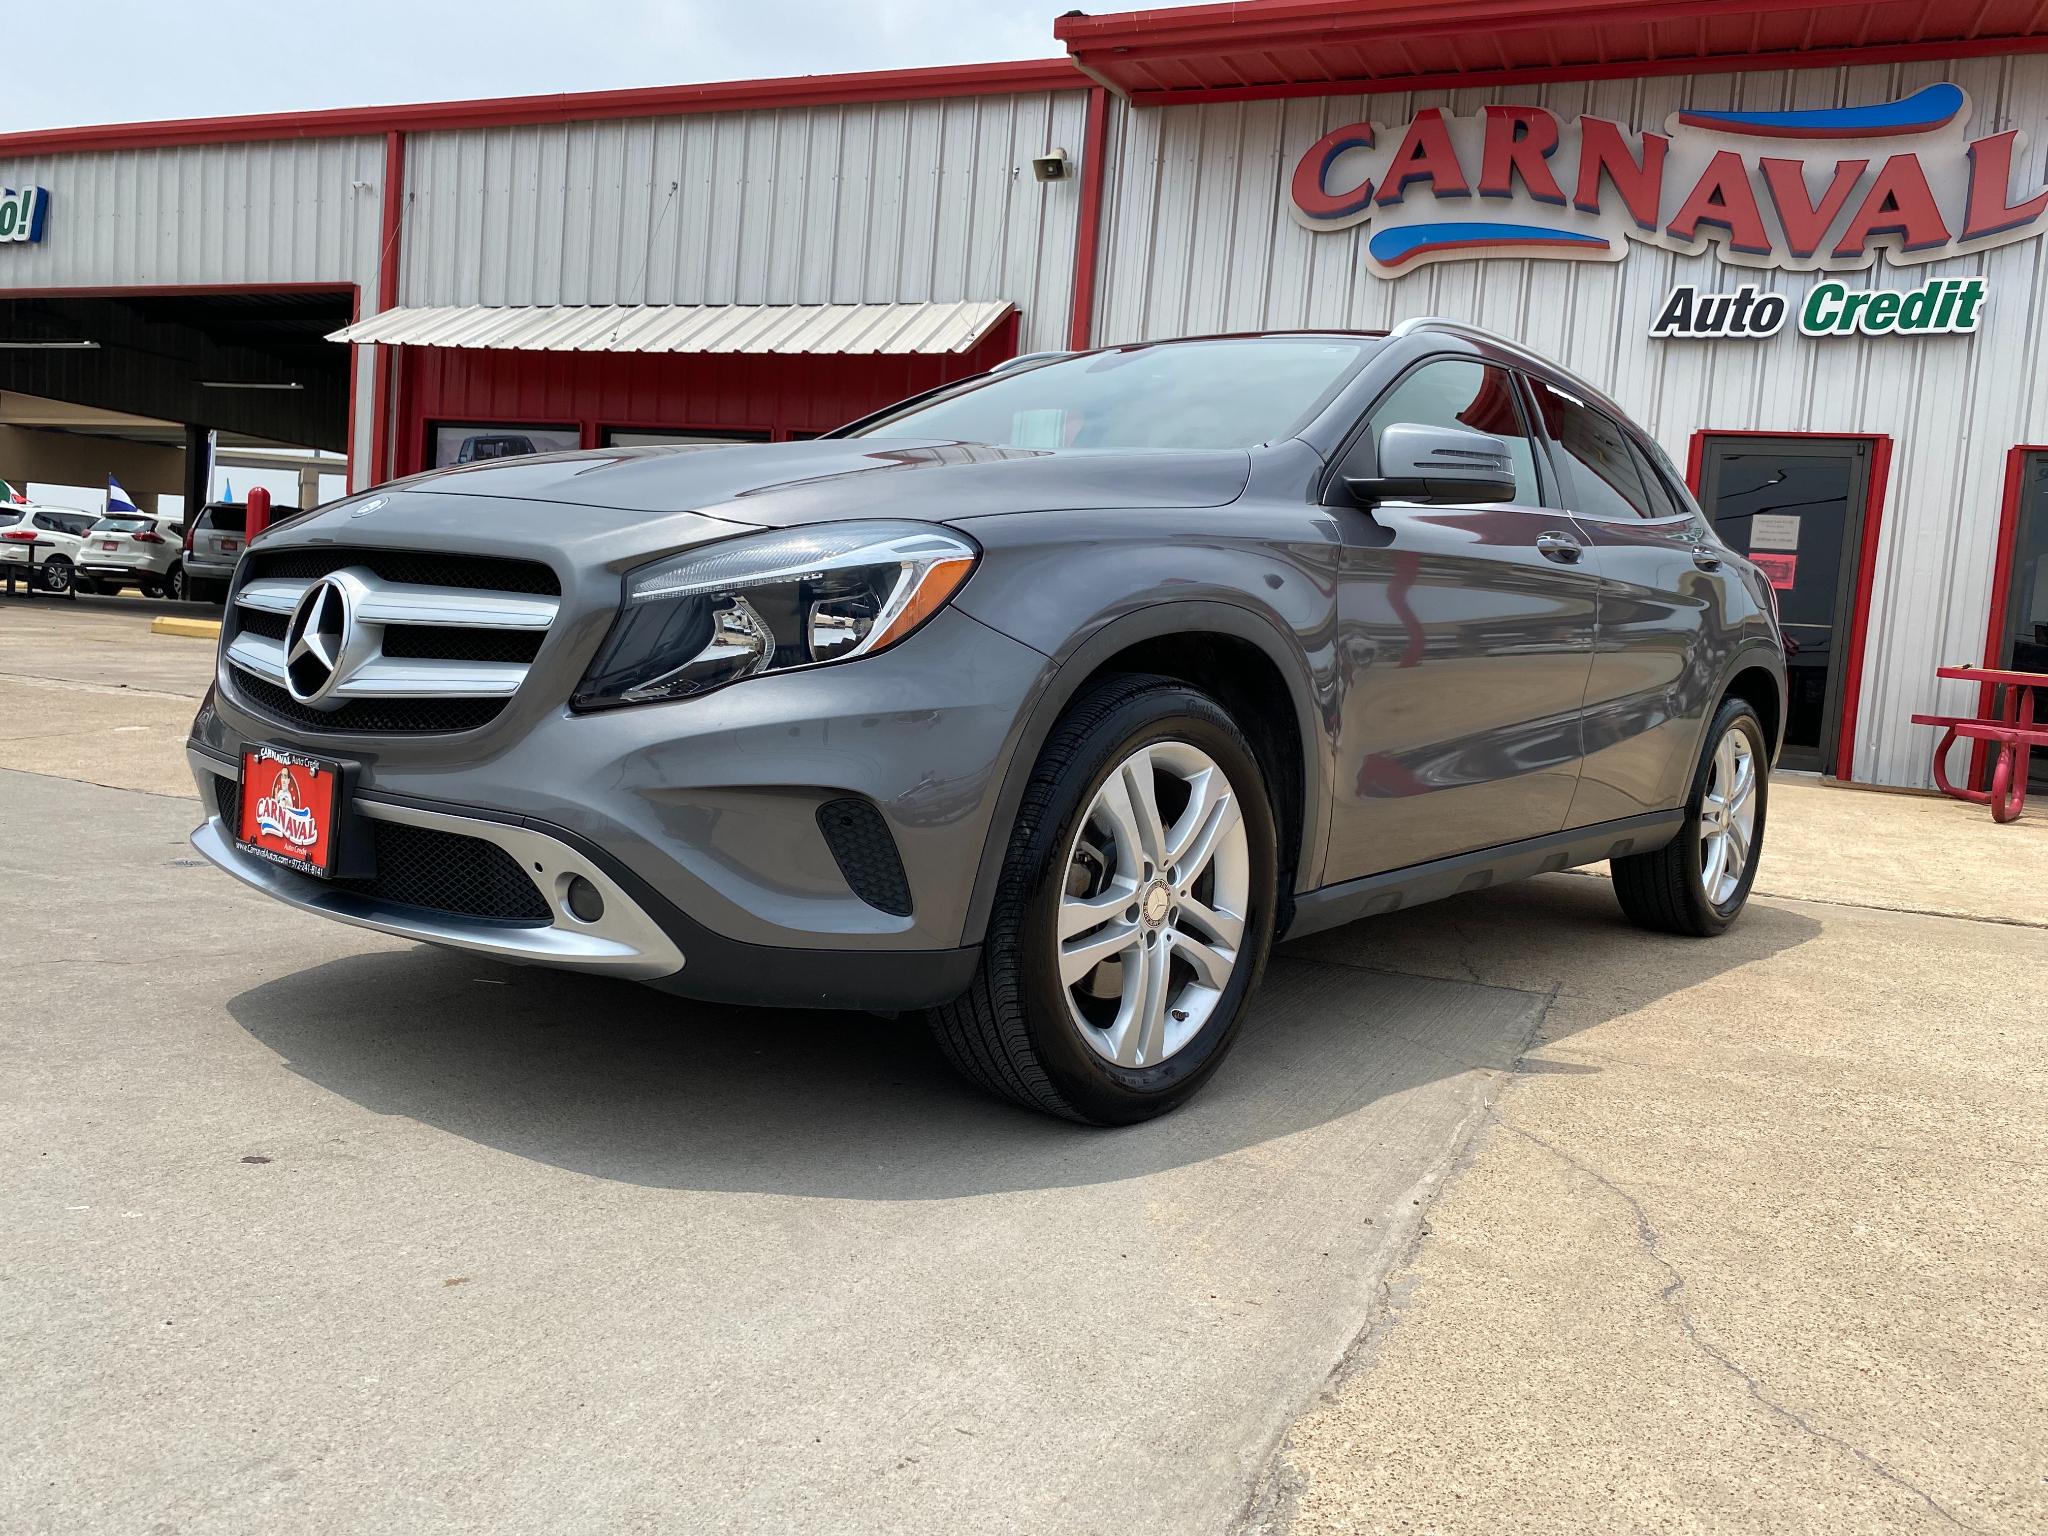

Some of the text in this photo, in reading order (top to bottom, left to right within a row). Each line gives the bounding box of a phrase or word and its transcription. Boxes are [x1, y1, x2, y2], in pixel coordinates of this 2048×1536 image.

[1291, 104, 2048, 258] CARNAVAL
[1653, 278, 1984, 334] Auto Credit
[260, 747, 291, 765] CARNAVAL
[292, 756, 304, 766] Auto
[256, 798, 316, 840] CARNAVAL
